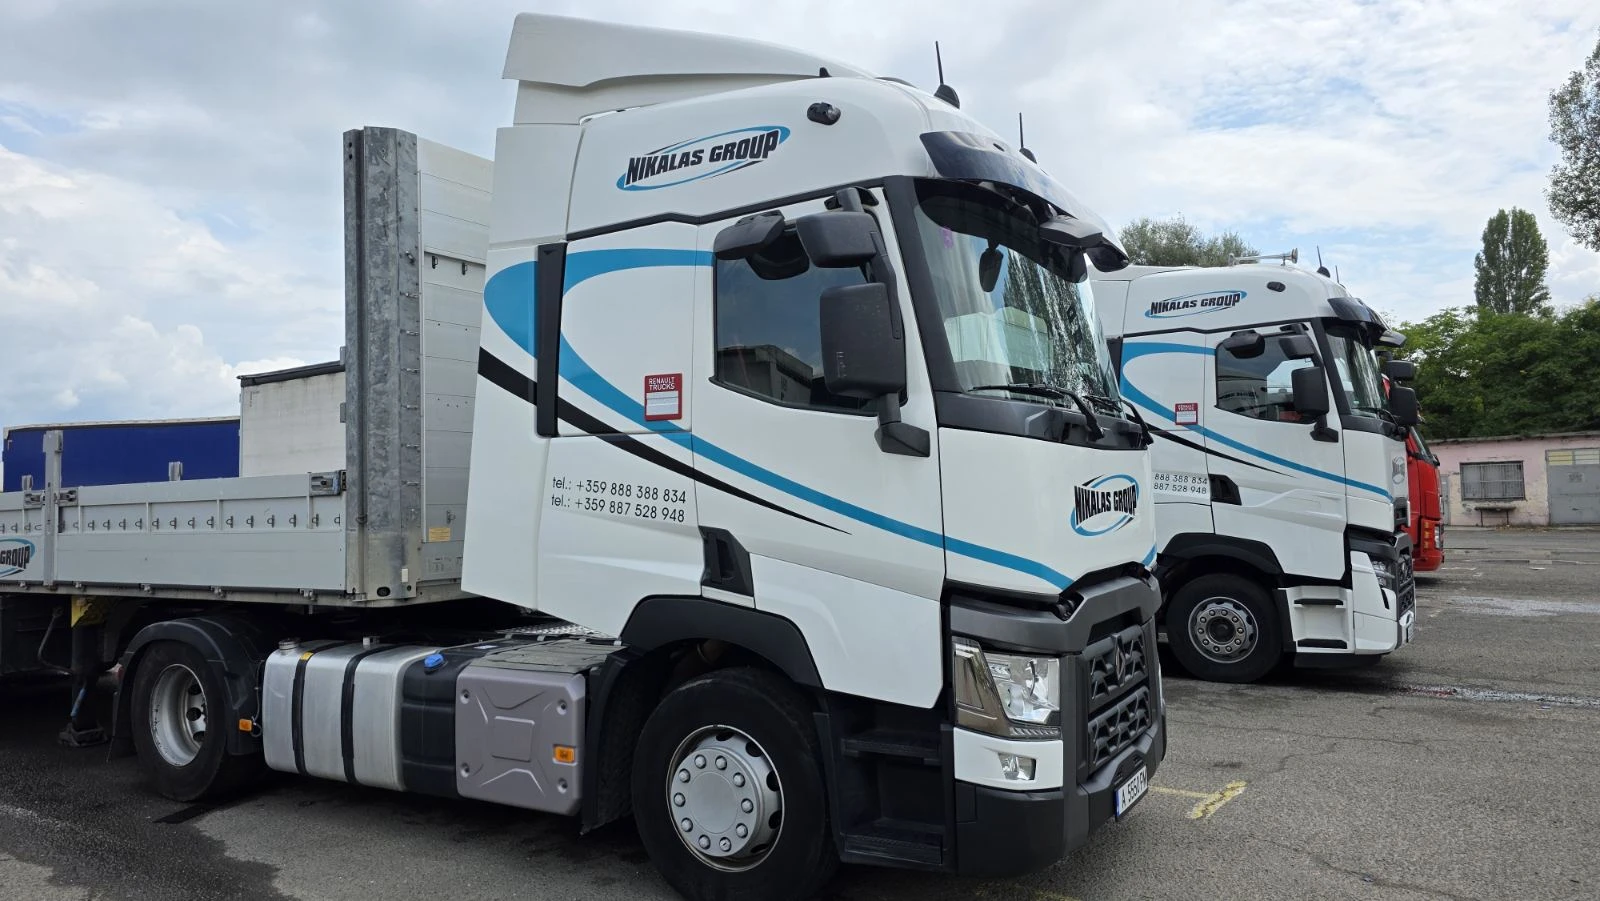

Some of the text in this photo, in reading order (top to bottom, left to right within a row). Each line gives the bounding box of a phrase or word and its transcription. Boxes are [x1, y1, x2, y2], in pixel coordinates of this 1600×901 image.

[625, 129, 779, 186] NIKALAS GROUP
[1150, 293, 1241, 315] NIKALAS GROUP
[648, 376, 675, 385] RENAULT
[648, 383, 675, 391] TRUCKS
[1153, 482, 1207, 495] 887 528 948
[1154, 473, 1170, 481] 888
[1173, 474, 1189, 483] 388
[552, 477, 686, 503] tel.: +359 888 388 834
[551, 494, 685, 522] tel.: +359 887 528 948
[1074, 484, 1137, 526] NIKALAS GROUP
[0, 545, 30, 569] GROUP
